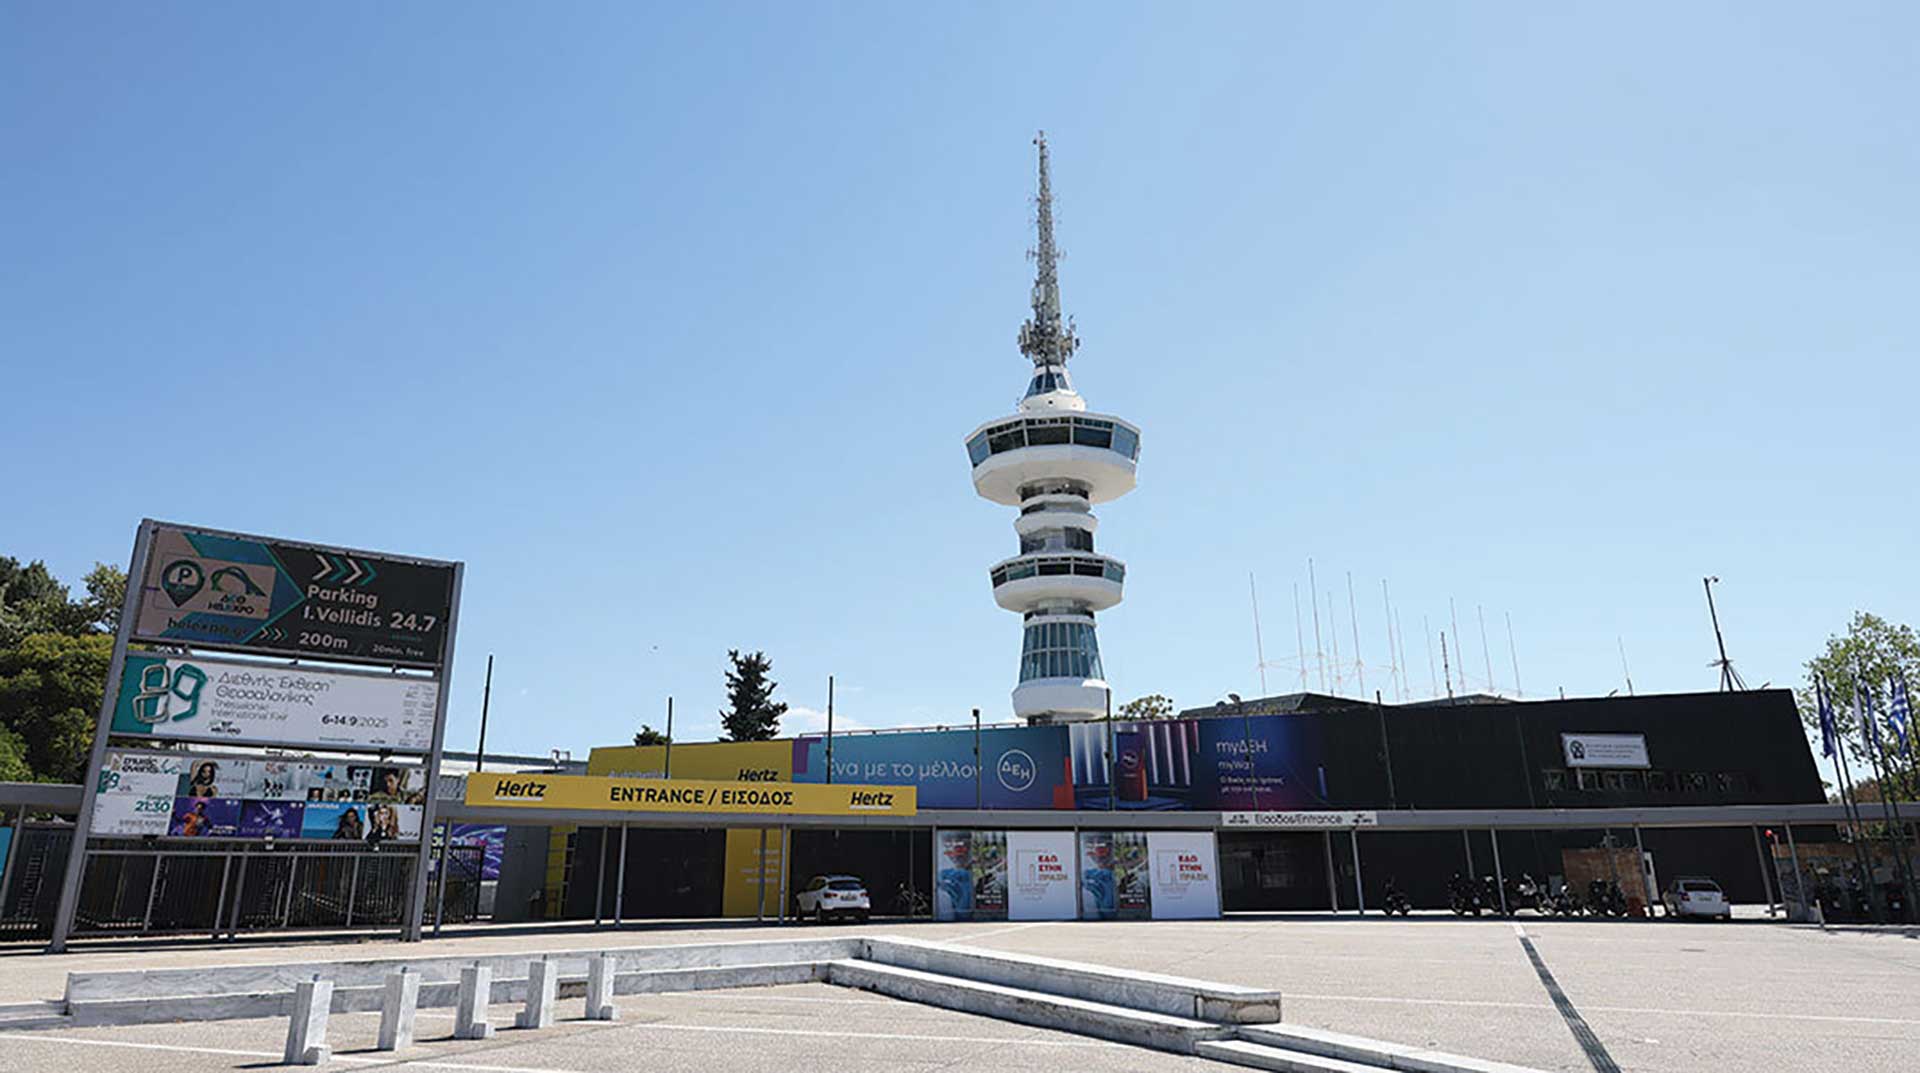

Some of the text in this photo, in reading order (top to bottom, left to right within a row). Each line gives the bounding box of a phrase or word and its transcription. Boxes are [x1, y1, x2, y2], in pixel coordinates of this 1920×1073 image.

[307, 584, 379, 609] Parking
[390, 611, 437, 632] 24.7
[299, 632, 348, 649] 200m
[218, 671, 275, 689] Διεθνής
[216, 684, 315, 706] Θεσσαλονίκης
[211, 708, 268, 720] International
[1215, 738, 1268, 756] myΔΕΗ
[122, 756, 158, 766] music
[864, 761, 886, 779] με
[891, 761, 914, 777] το
[1002, 760, 1031, 780] ΔΕΗ
[737, 767, 778, 782] Hertz
[494, 780, 547, 798] Hertz
[610, 786, 794, 806] ENTRANCE / ΕΙΣΟΔΟΣ
[135, 799, 170, 813] 21:30
[850, 791, 894, 807] Hertz
